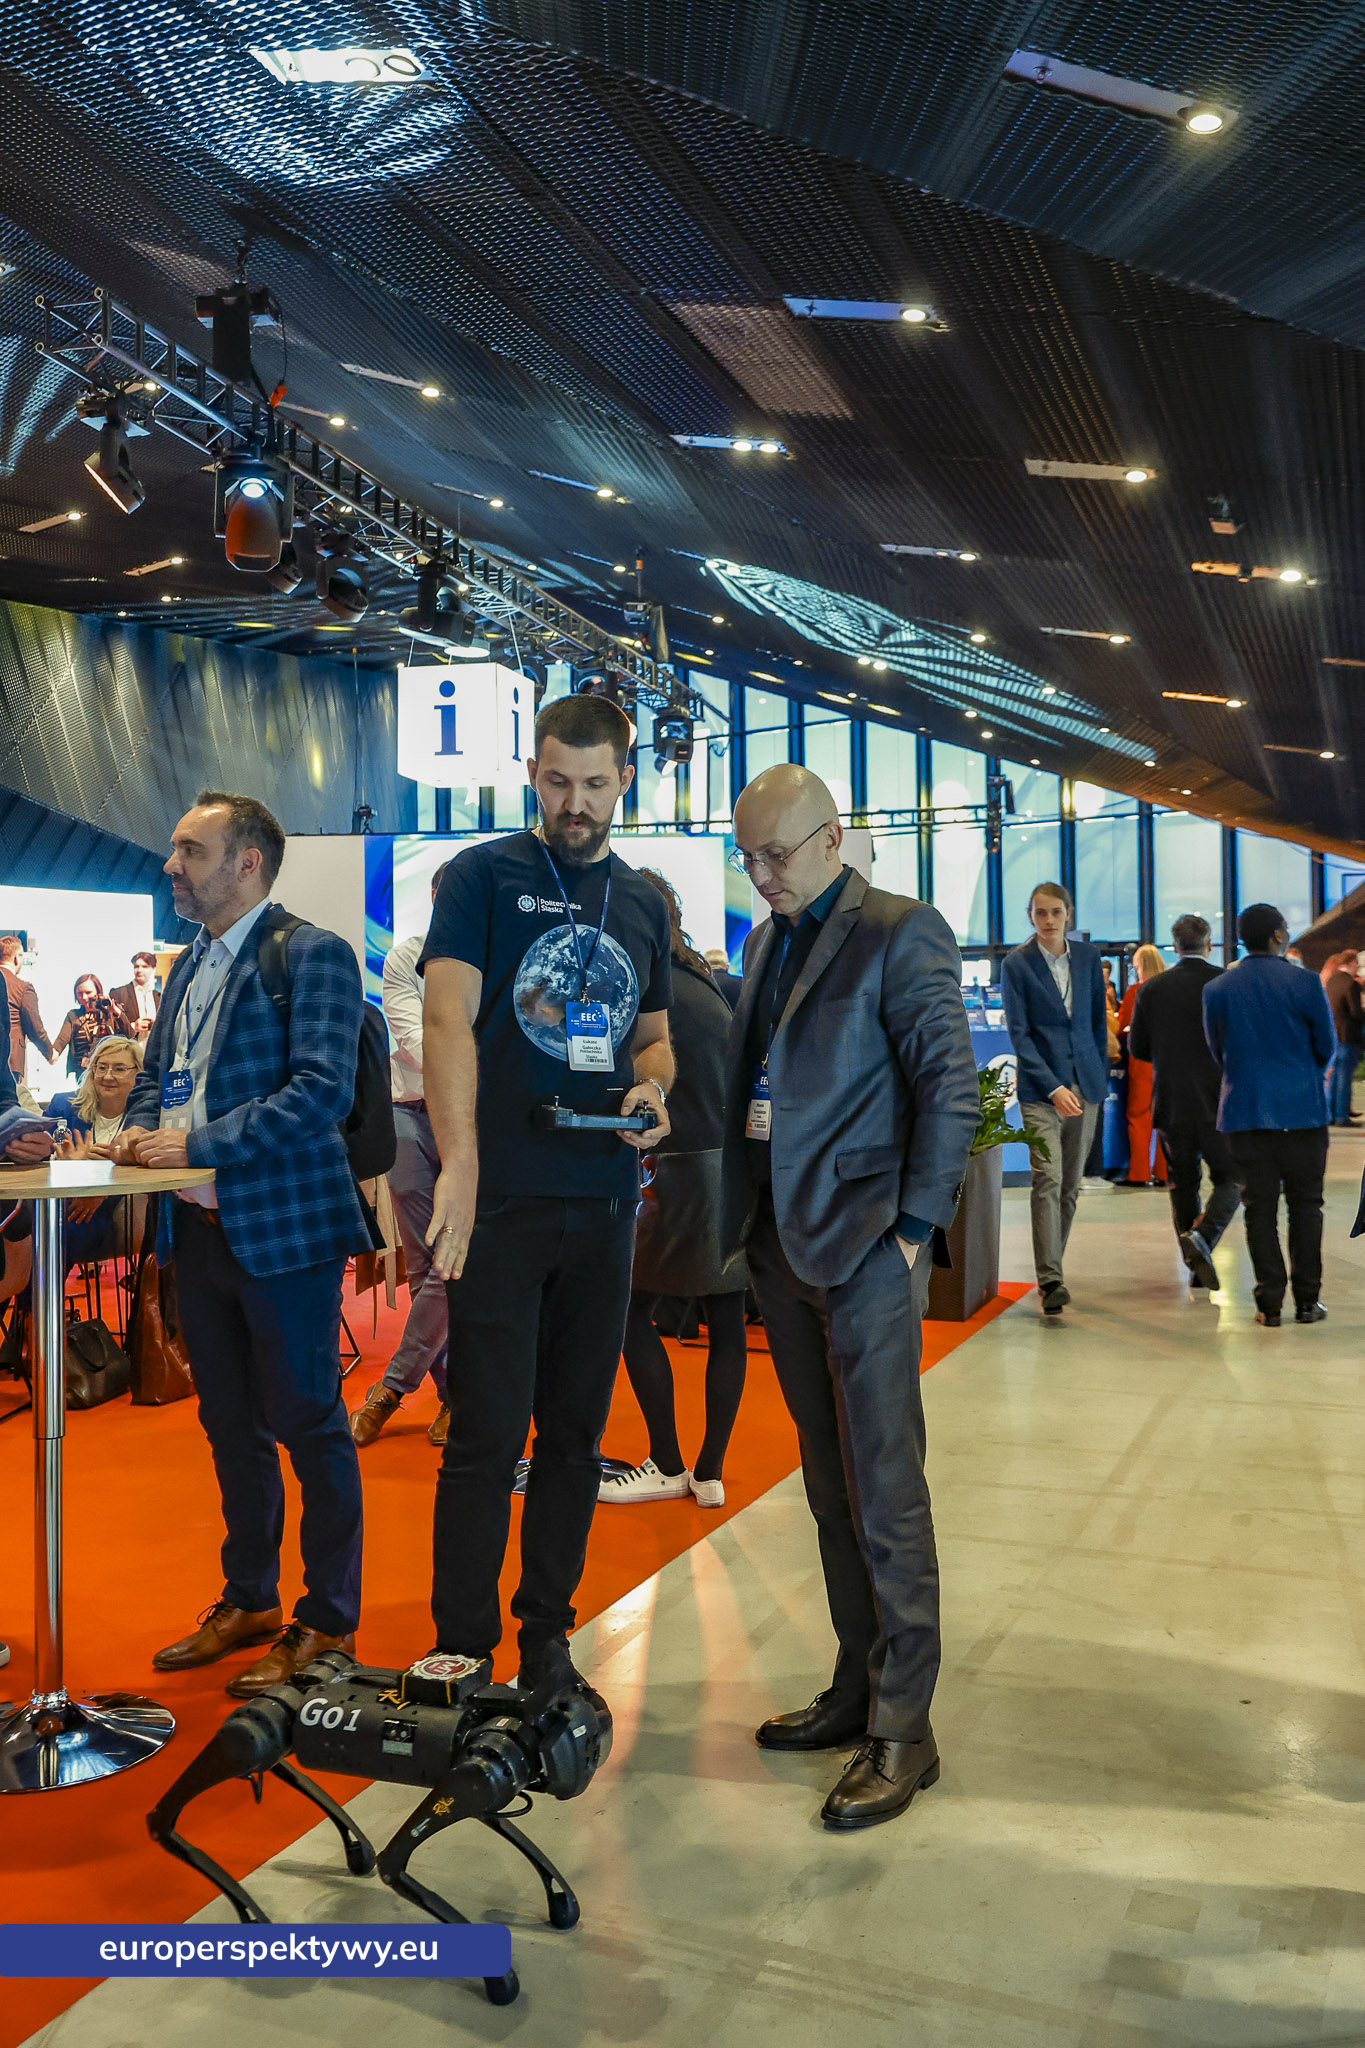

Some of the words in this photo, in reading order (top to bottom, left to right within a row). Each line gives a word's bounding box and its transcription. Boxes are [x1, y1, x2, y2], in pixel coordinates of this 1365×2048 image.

[434, 680, 463, 756] i
[511, 687, 521, 762] i
[581, 1012, 597, 1022] EEC
[173, 1078, 186, 1088] EEC
[300, 1697, 362, 1732] Go1
